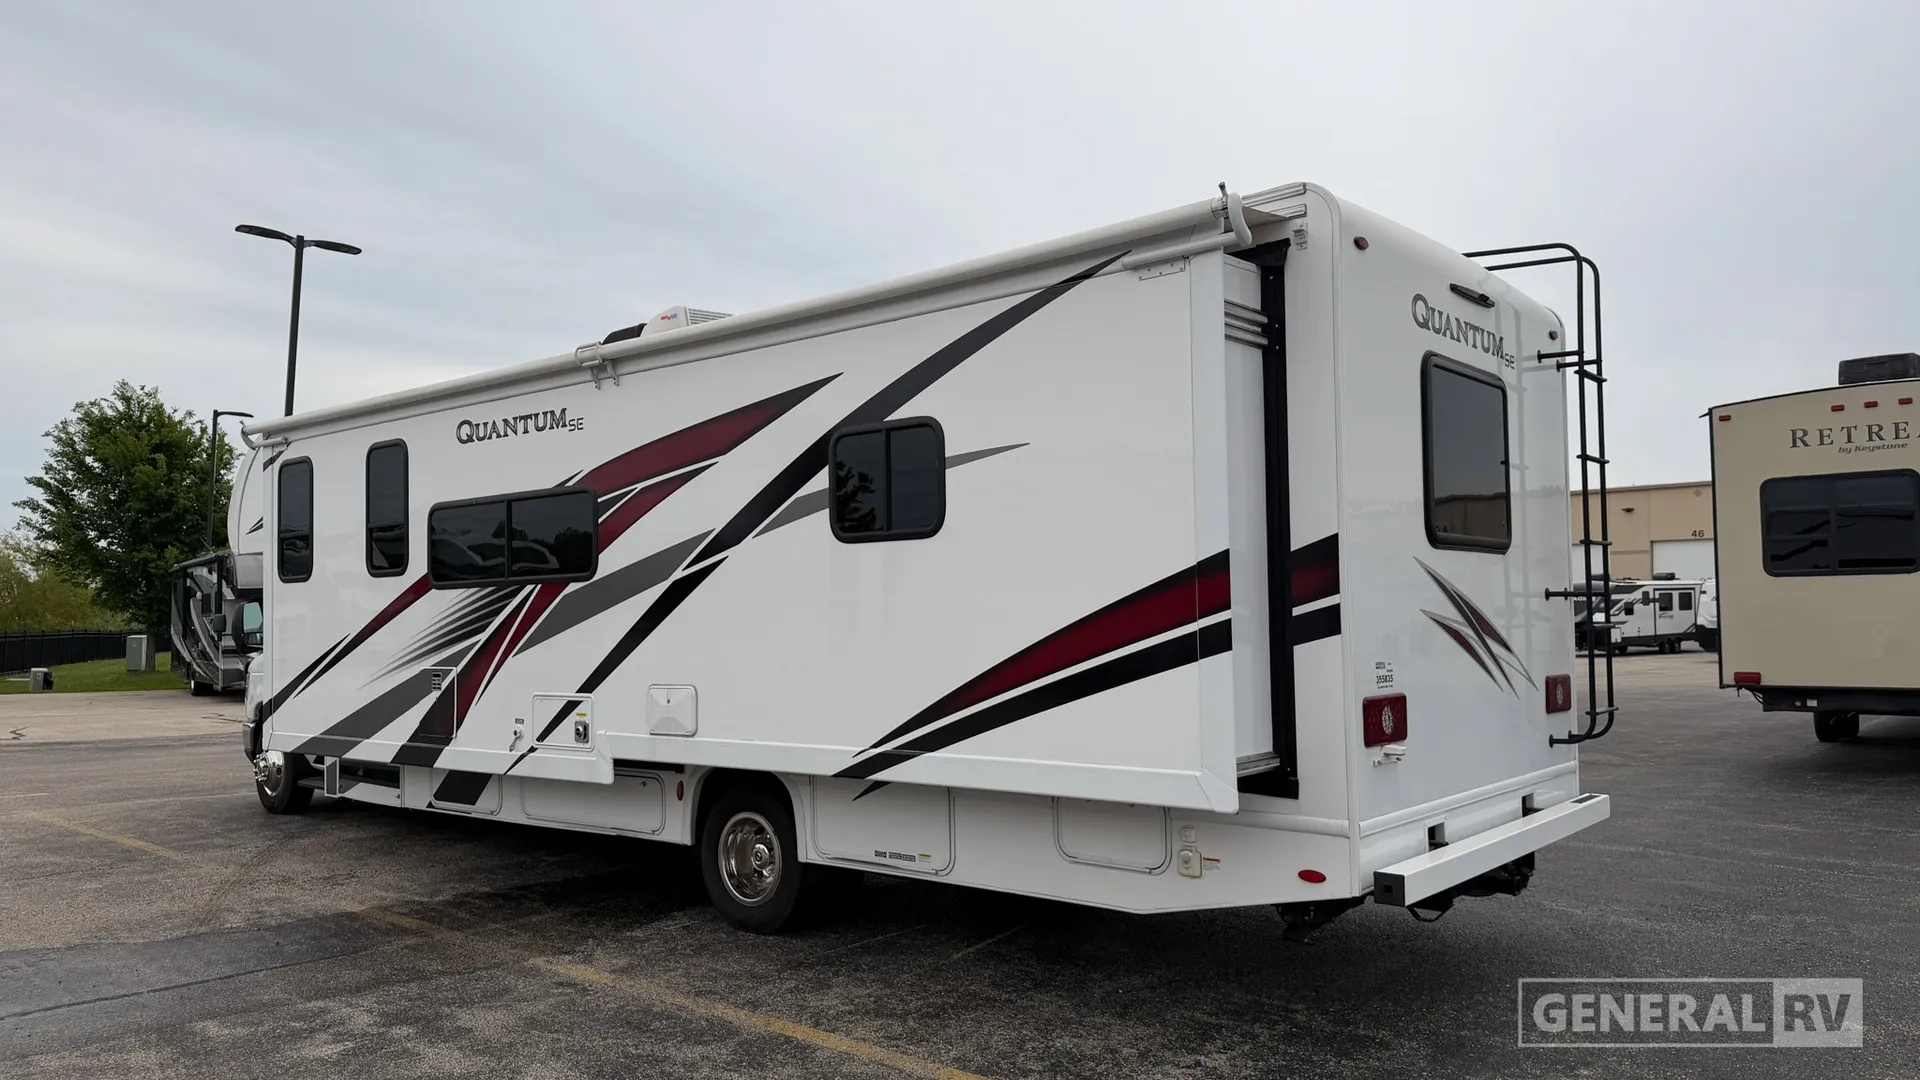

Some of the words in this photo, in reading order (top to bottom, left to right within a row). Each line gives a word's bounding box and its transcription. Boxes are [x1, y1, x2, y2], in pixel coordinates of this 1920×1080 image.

[1411, 293, 1505, 360] QUANTUM
[1504, 352, 1516, 370] SE
[456, 407, 568, 444] QUANTUM
[568, 417, 584, 432] SE
[1789, 421, 1920, 448] RETRE
[1838, 446, 1853, 454] by
[1854, 442, 1909, 453] Keystone
[1691, 529, 1705, 538] 46
